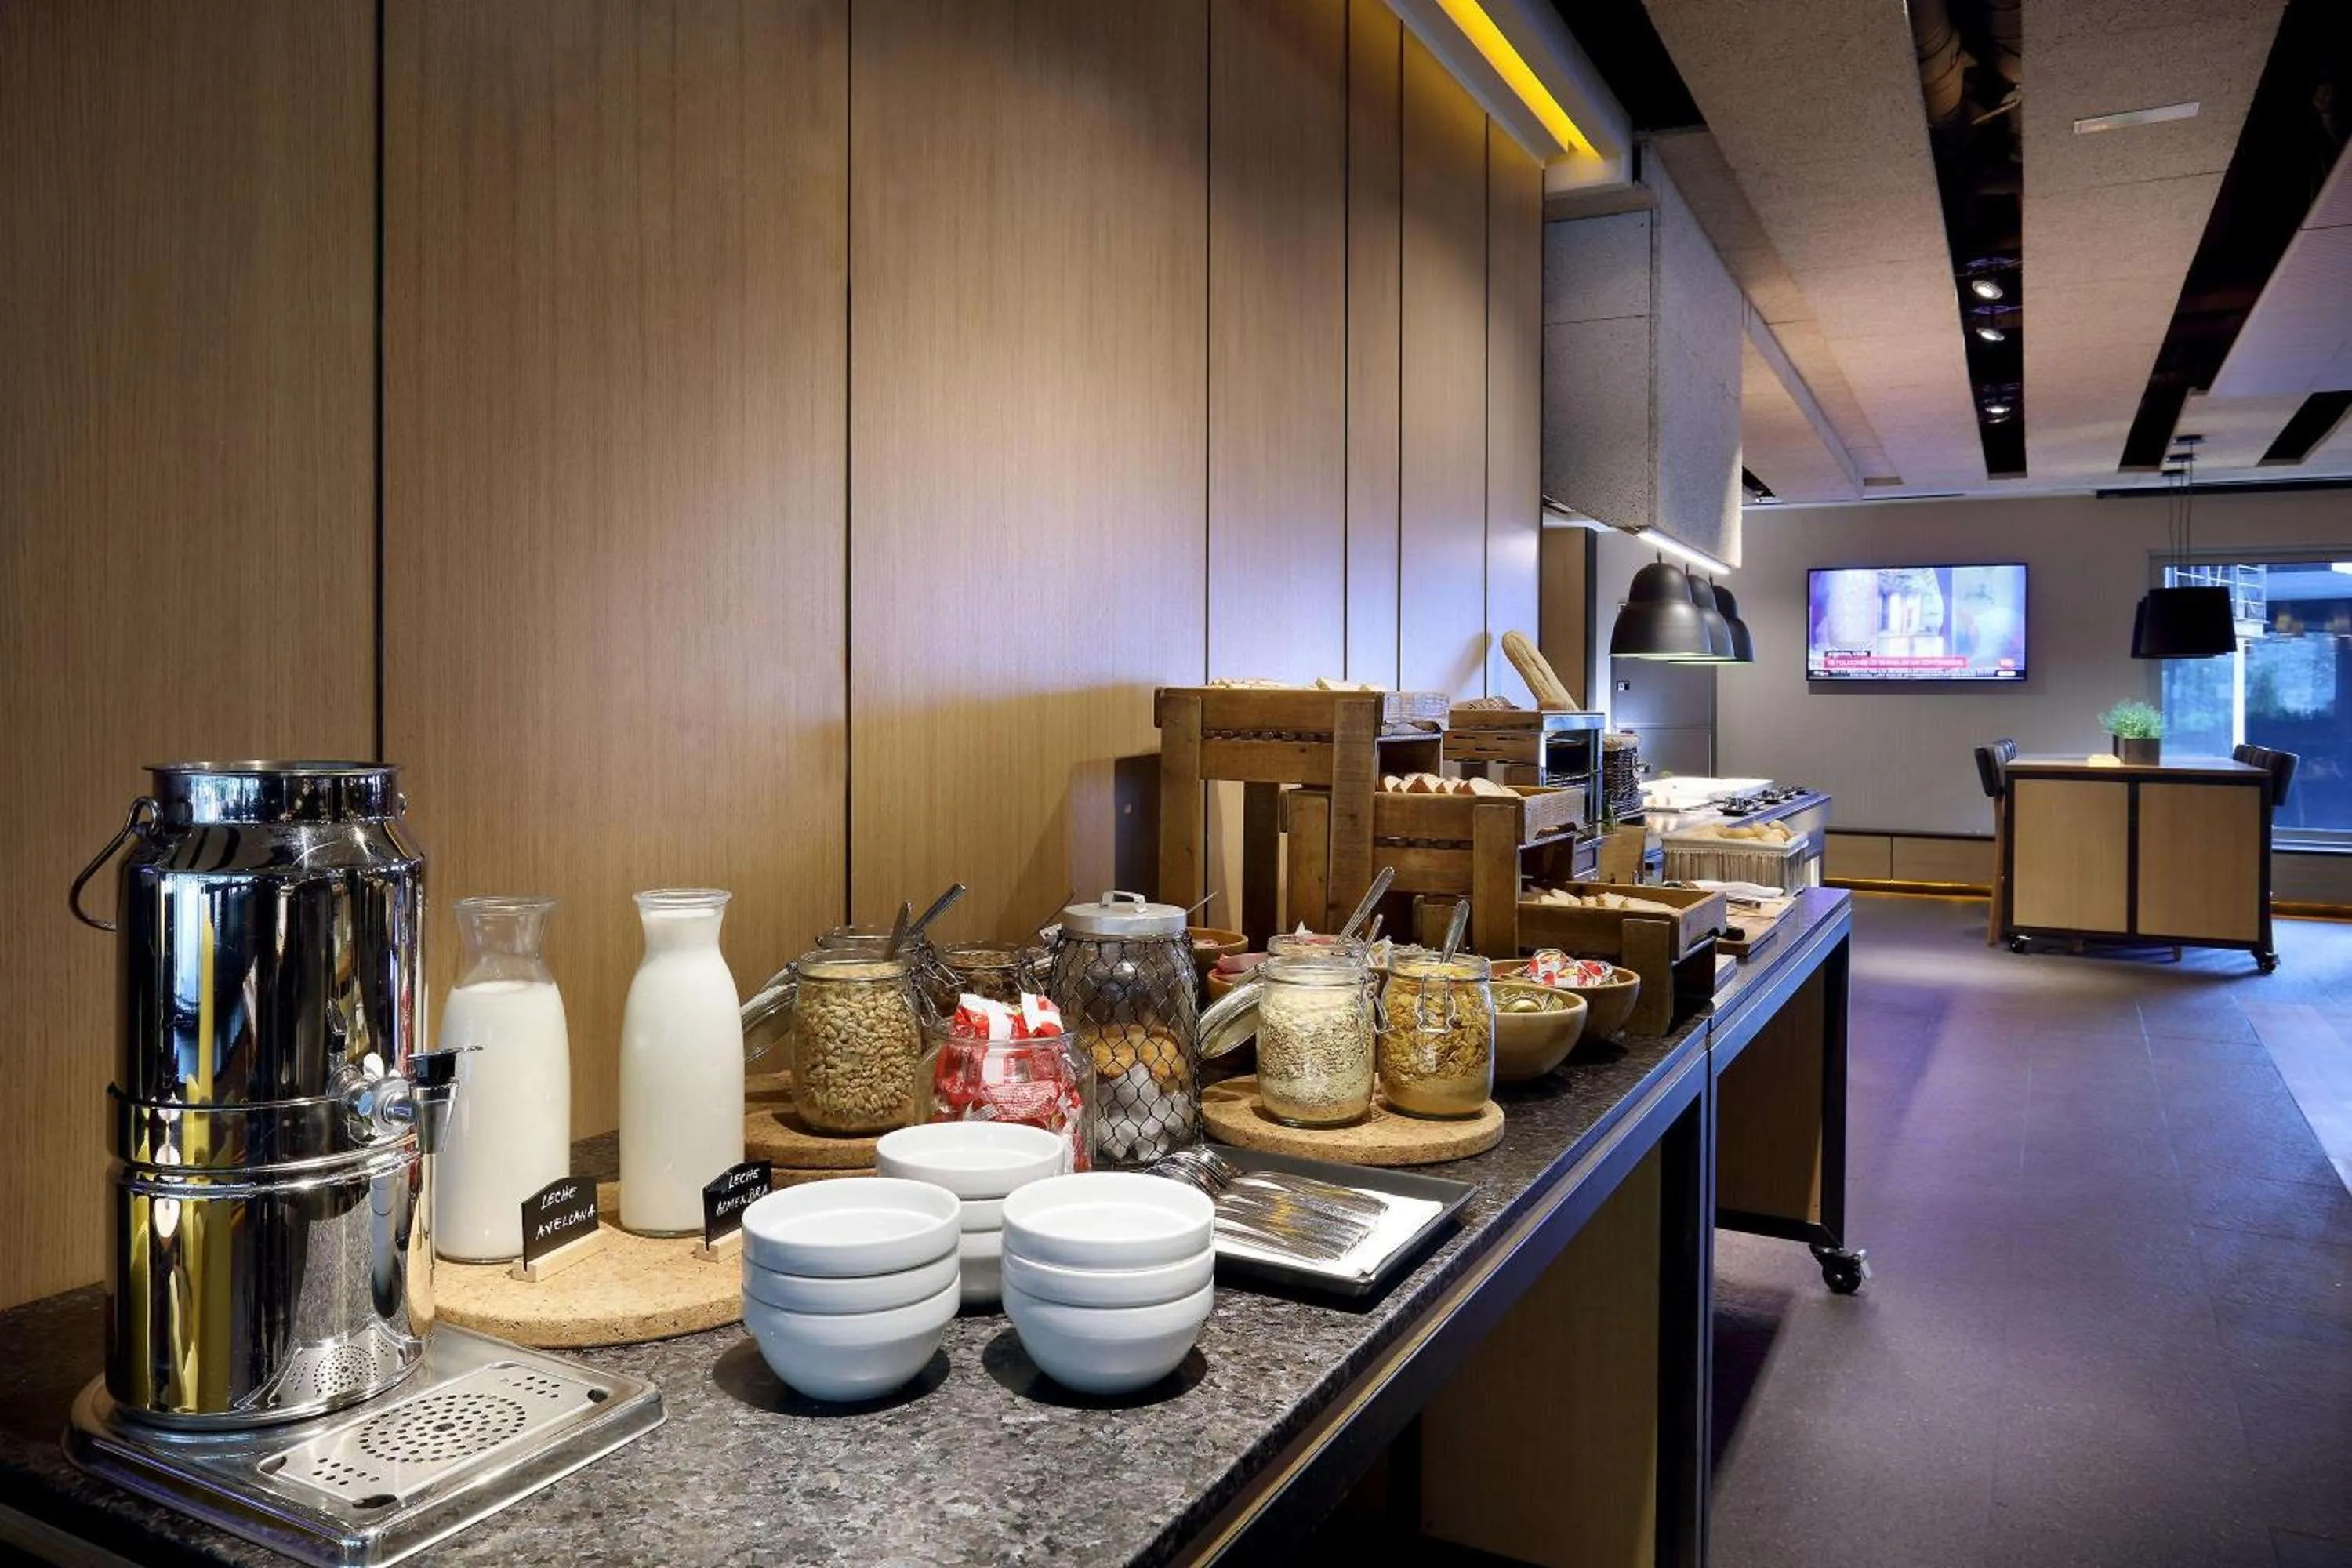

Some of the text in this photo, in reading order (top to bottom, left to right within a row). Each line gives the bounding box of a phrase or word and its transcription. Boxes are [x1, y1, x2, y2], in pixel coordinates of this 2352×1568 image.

[728, 1168, 760, 1189] LECHE
[541, 1185, 577, 1210] LECHE
[535, 1203, 595, 1240] AVELLANA
